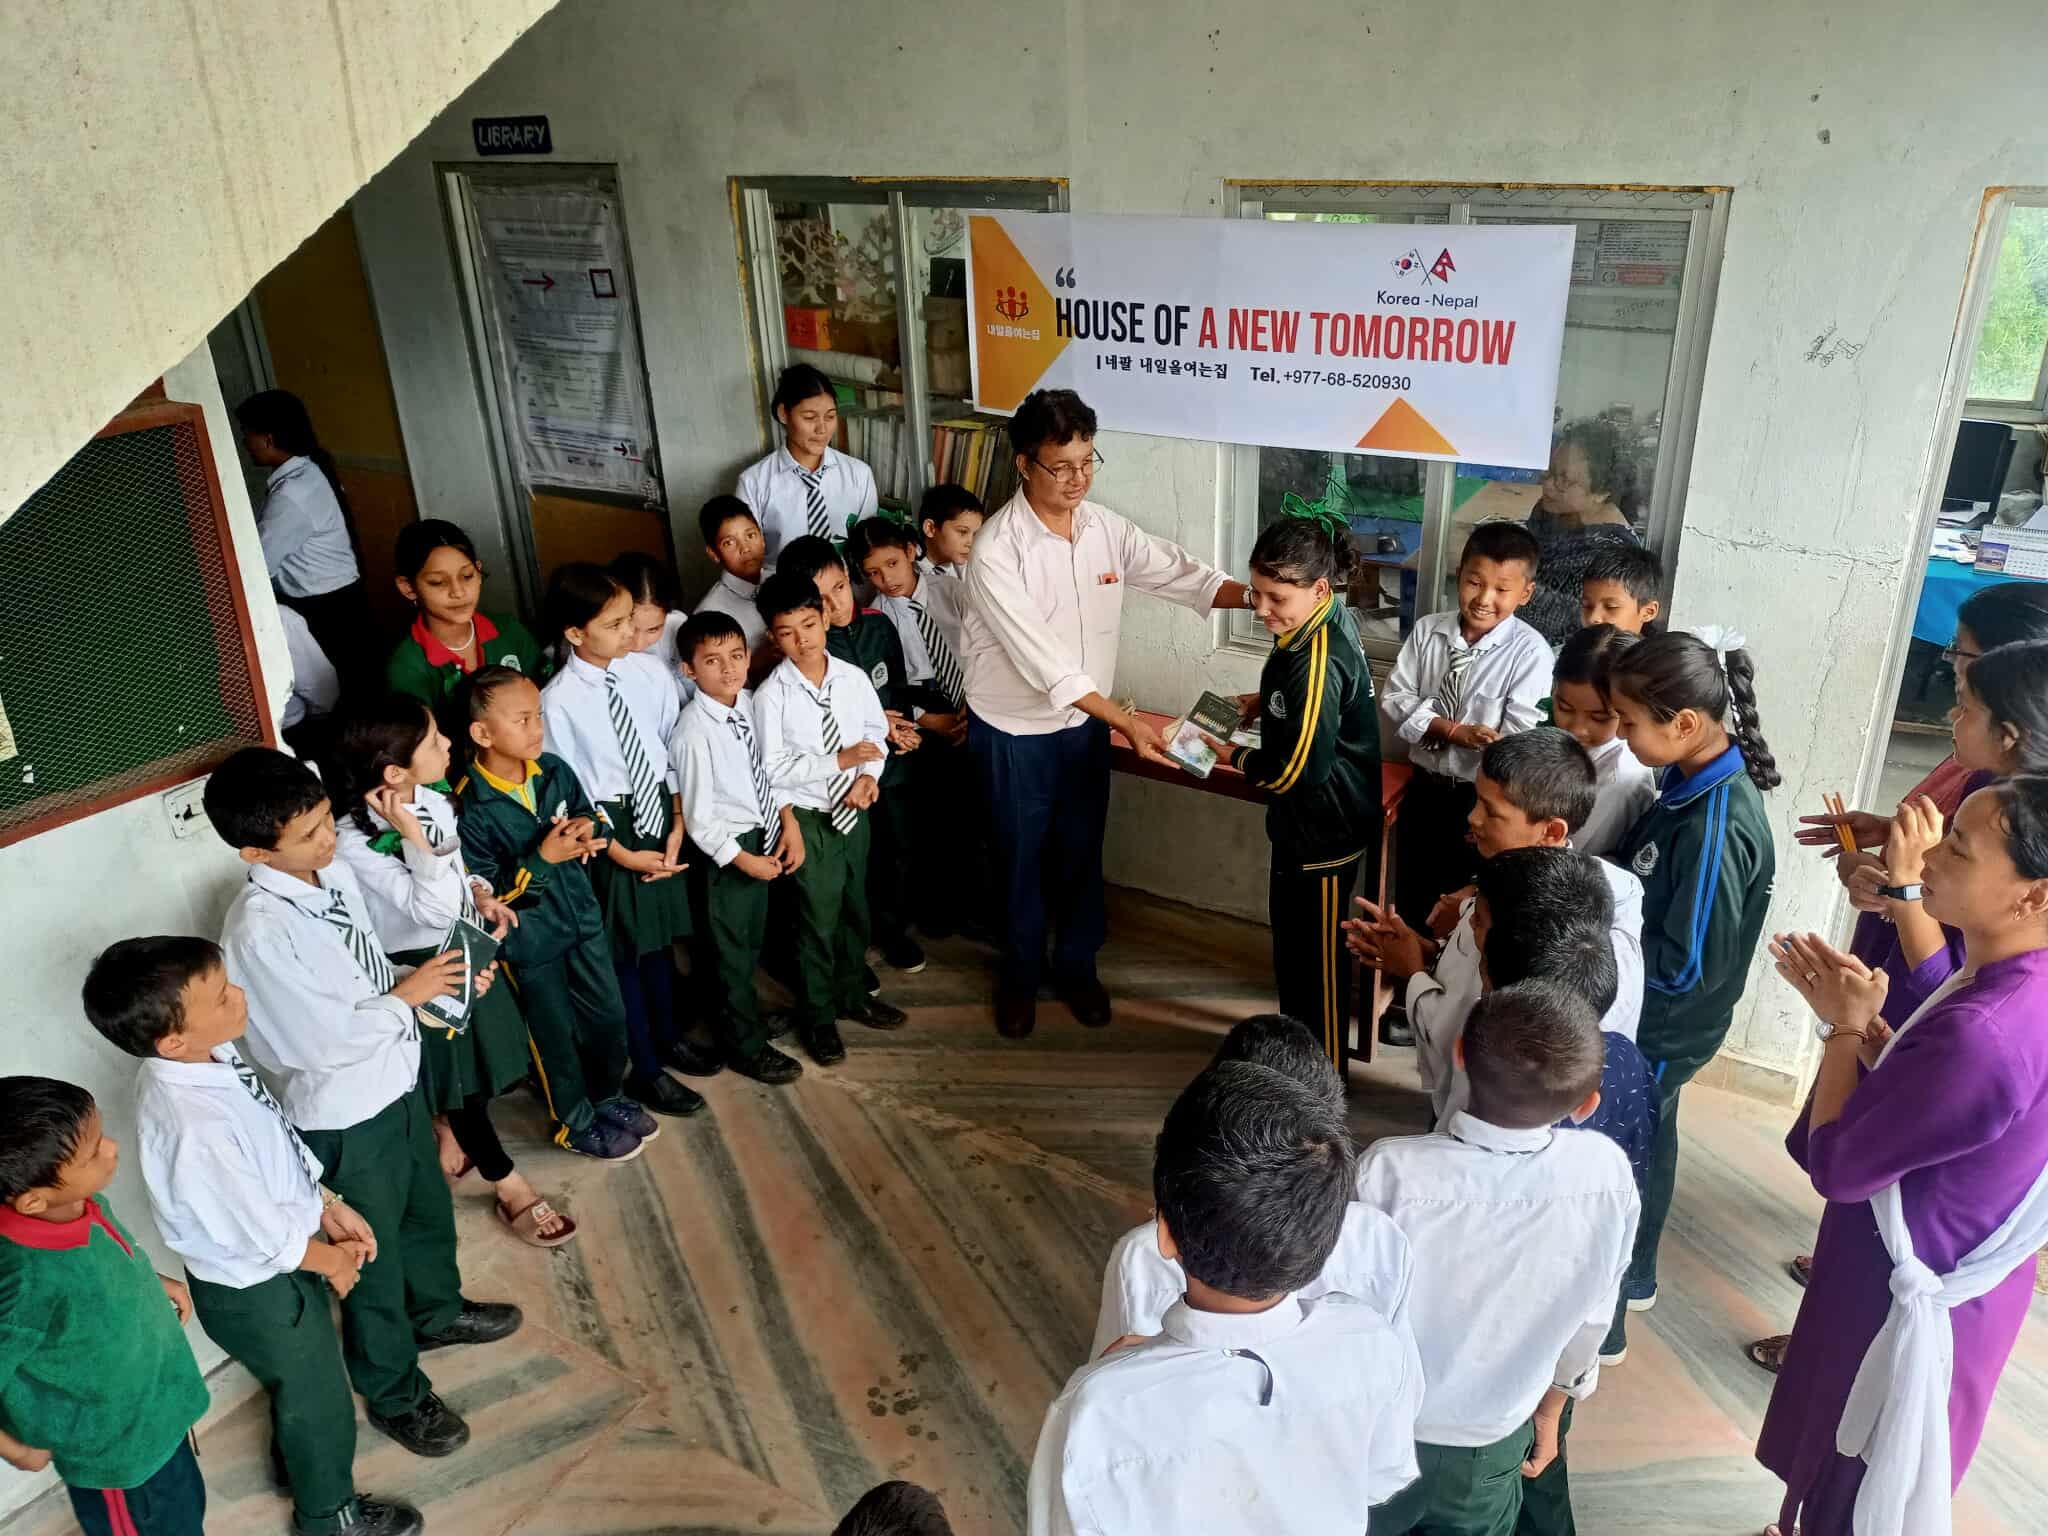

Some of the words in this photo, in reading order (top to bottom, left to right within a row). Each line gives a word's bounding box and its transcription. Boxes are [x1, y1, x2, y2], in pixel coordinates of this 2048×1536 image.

[478, 124, 545, 149] LIBRARY
[1376, 290, 1420, 306] Korea
[1056, 298, 1145, 344] HOUSE
[1154, 304, 1190, 346] OF
[1198, 307, 1218, 350] A
[1228, 308, 1300, 353] NEW
[1310, 312, 1516, 366] TOMORROW
[1105, 355, 1133, 371] 네팔
[1140, 357, 1228, 380] 내일을여는집
[1283, 369, 1411, 391] +977-68-520930
